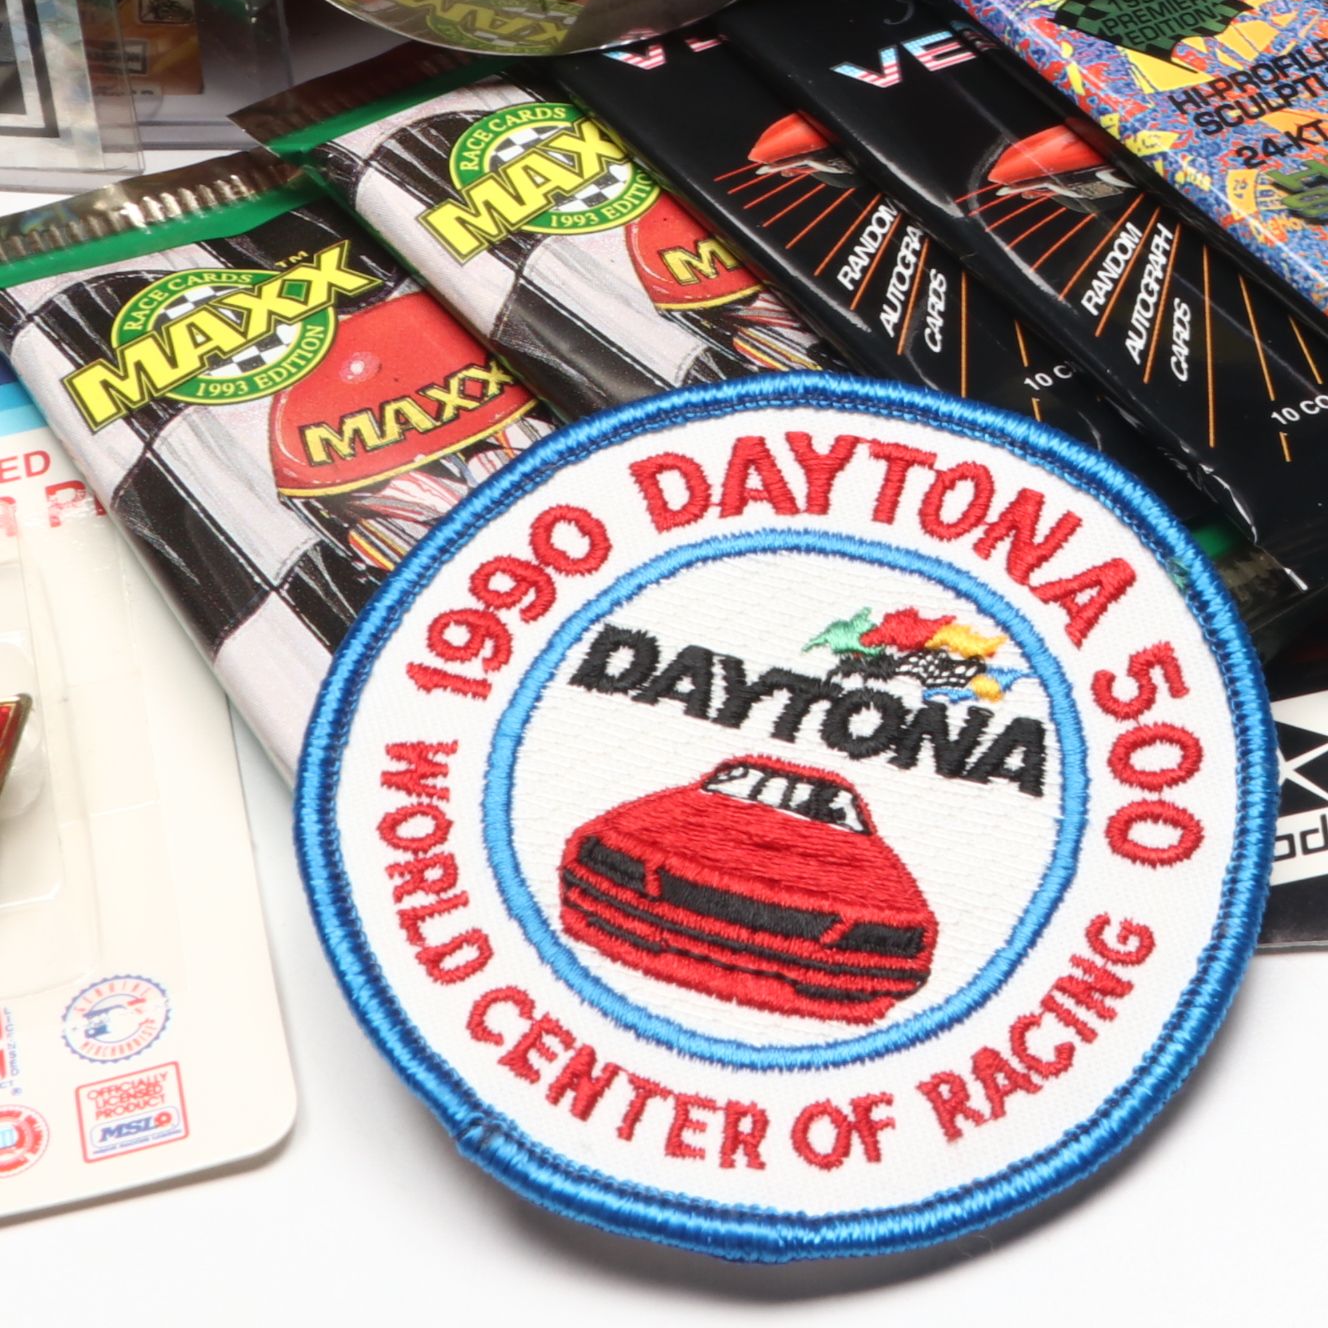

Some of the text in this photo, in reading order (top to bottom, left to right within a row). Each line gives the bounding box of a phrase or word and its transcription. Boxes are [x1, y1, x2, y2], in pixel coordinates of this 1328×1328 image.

[1125, 6, 1218, 47] EDITION
[459, 106, 567, 172] RACE CARDS
[550, 211, 599, 228] 1993
[123, 271, 254, 333] RACE CARDS
[879, 224, 925, 339] AUTOGRA
[1080, 221, 1142, 318] RANDOM
[1123, 222, 1175, 366] AUTOGRAPH
[61, 239, 384, 434] MAXX
[923, 268, 948, 354] CARDS
[1170, 296, 1192, 383] CARDS
[195, 324, 325, 398] 1993 EDITION
[1023, 369, 1054, 392] 10
[299, 360, 516, 467] MAXX
[1270, 404, 1299, 426] 10
[405, 430, 1205, 870] 1990 DAYTONA 500
[567, 623, 1051, 801] DAYTONA
[375, 738, 1157, 1172] WORLD CENTER OF RACING
[86, 1071, 169, 1100] OFFICIALLY
[94, 1082, 164, 1111] LICENSED
[95, 1094, 166, 1121] PRODUCT
